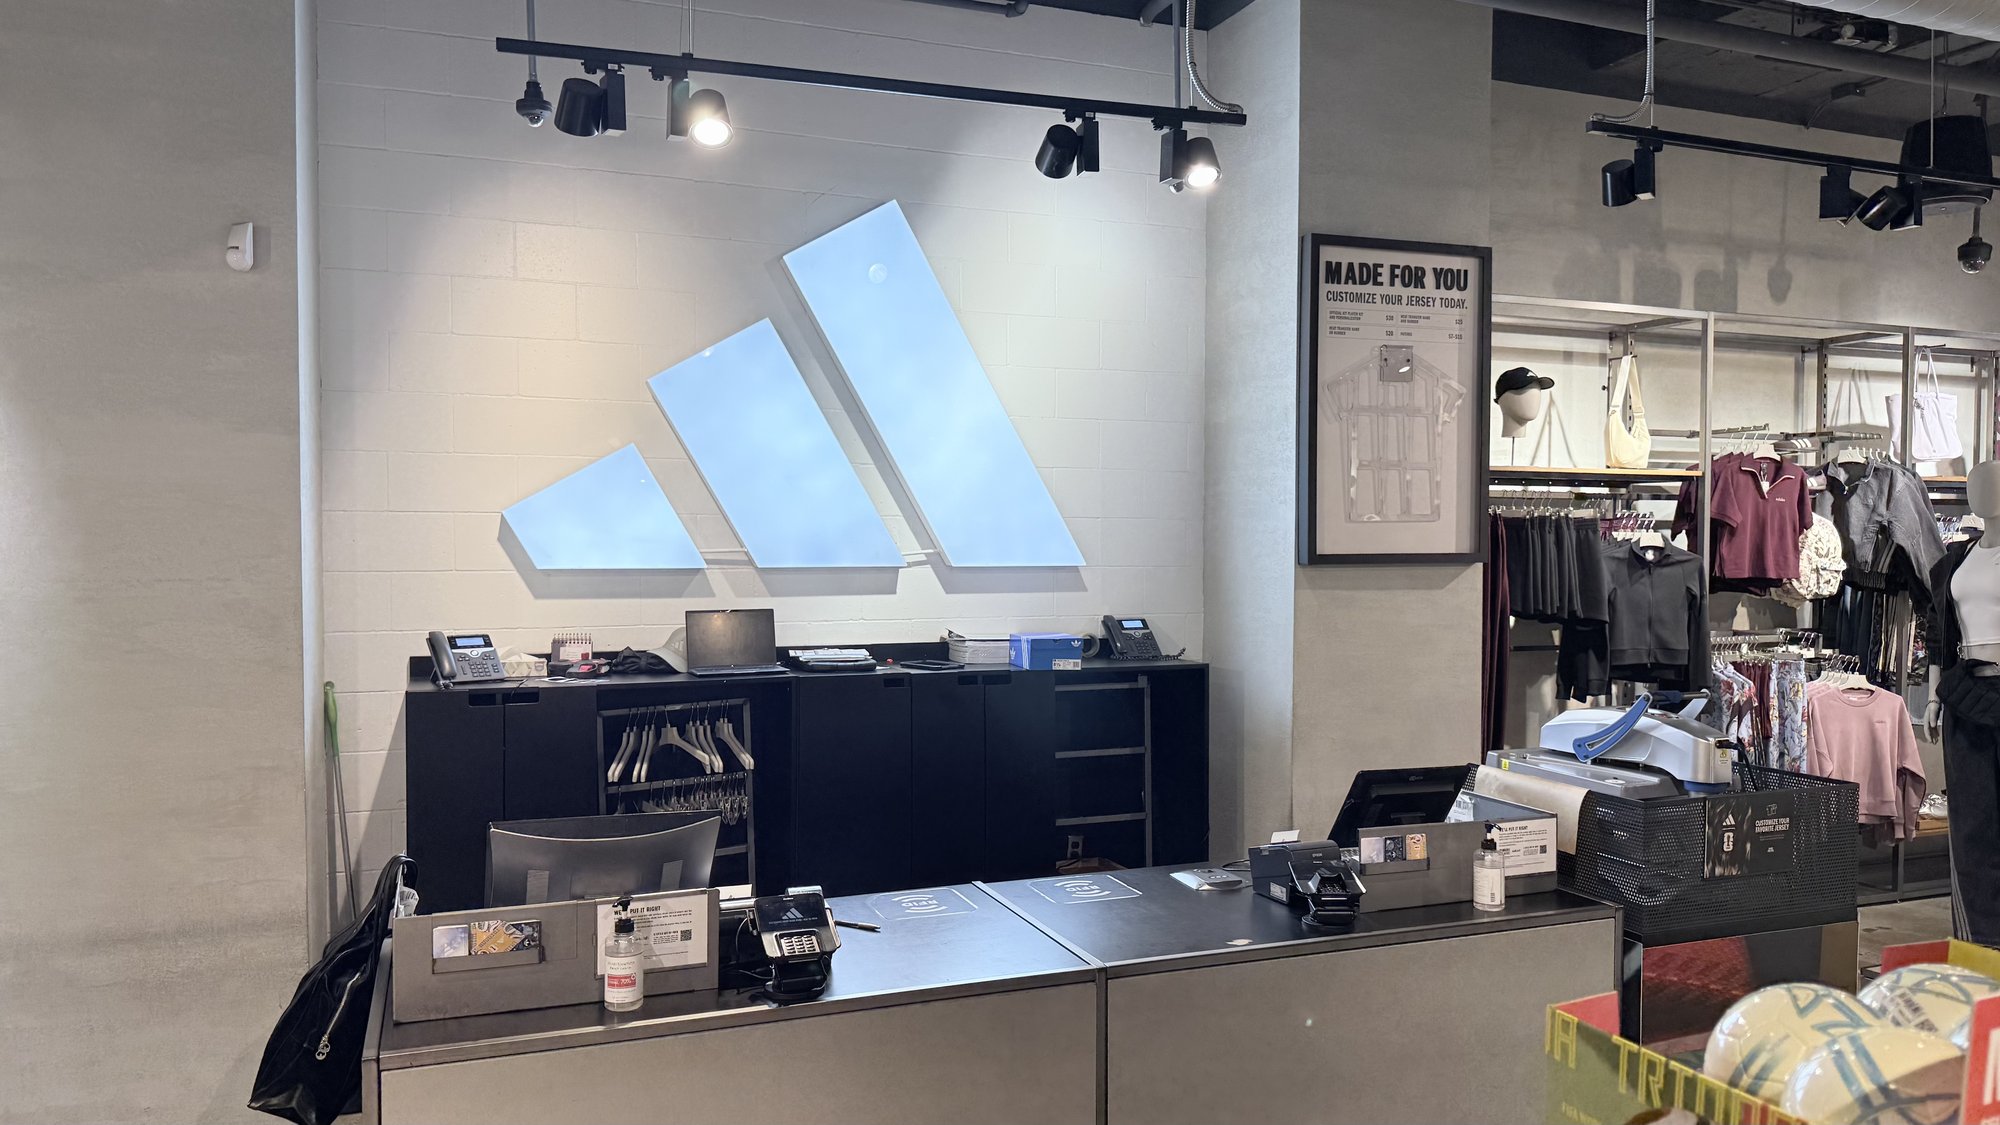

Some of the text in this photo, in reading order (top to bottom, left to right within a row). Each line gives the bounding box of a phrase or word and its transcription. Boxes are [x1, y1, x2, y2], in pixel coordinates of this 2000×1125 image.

[1324, 260, 1469, 292] MADE FOR YOU
[1326, 290, 1468, 310] CUSTOMIZE YOUR JERSEY TODAY.
[1755, 818, 1778, 827] CUSTOMIZE
[1755, 824, 1790, 833] FAVORITE JERSEY
[1065, 883, 1100, 893] RFID
[901, 899, 939, 908] RFID
